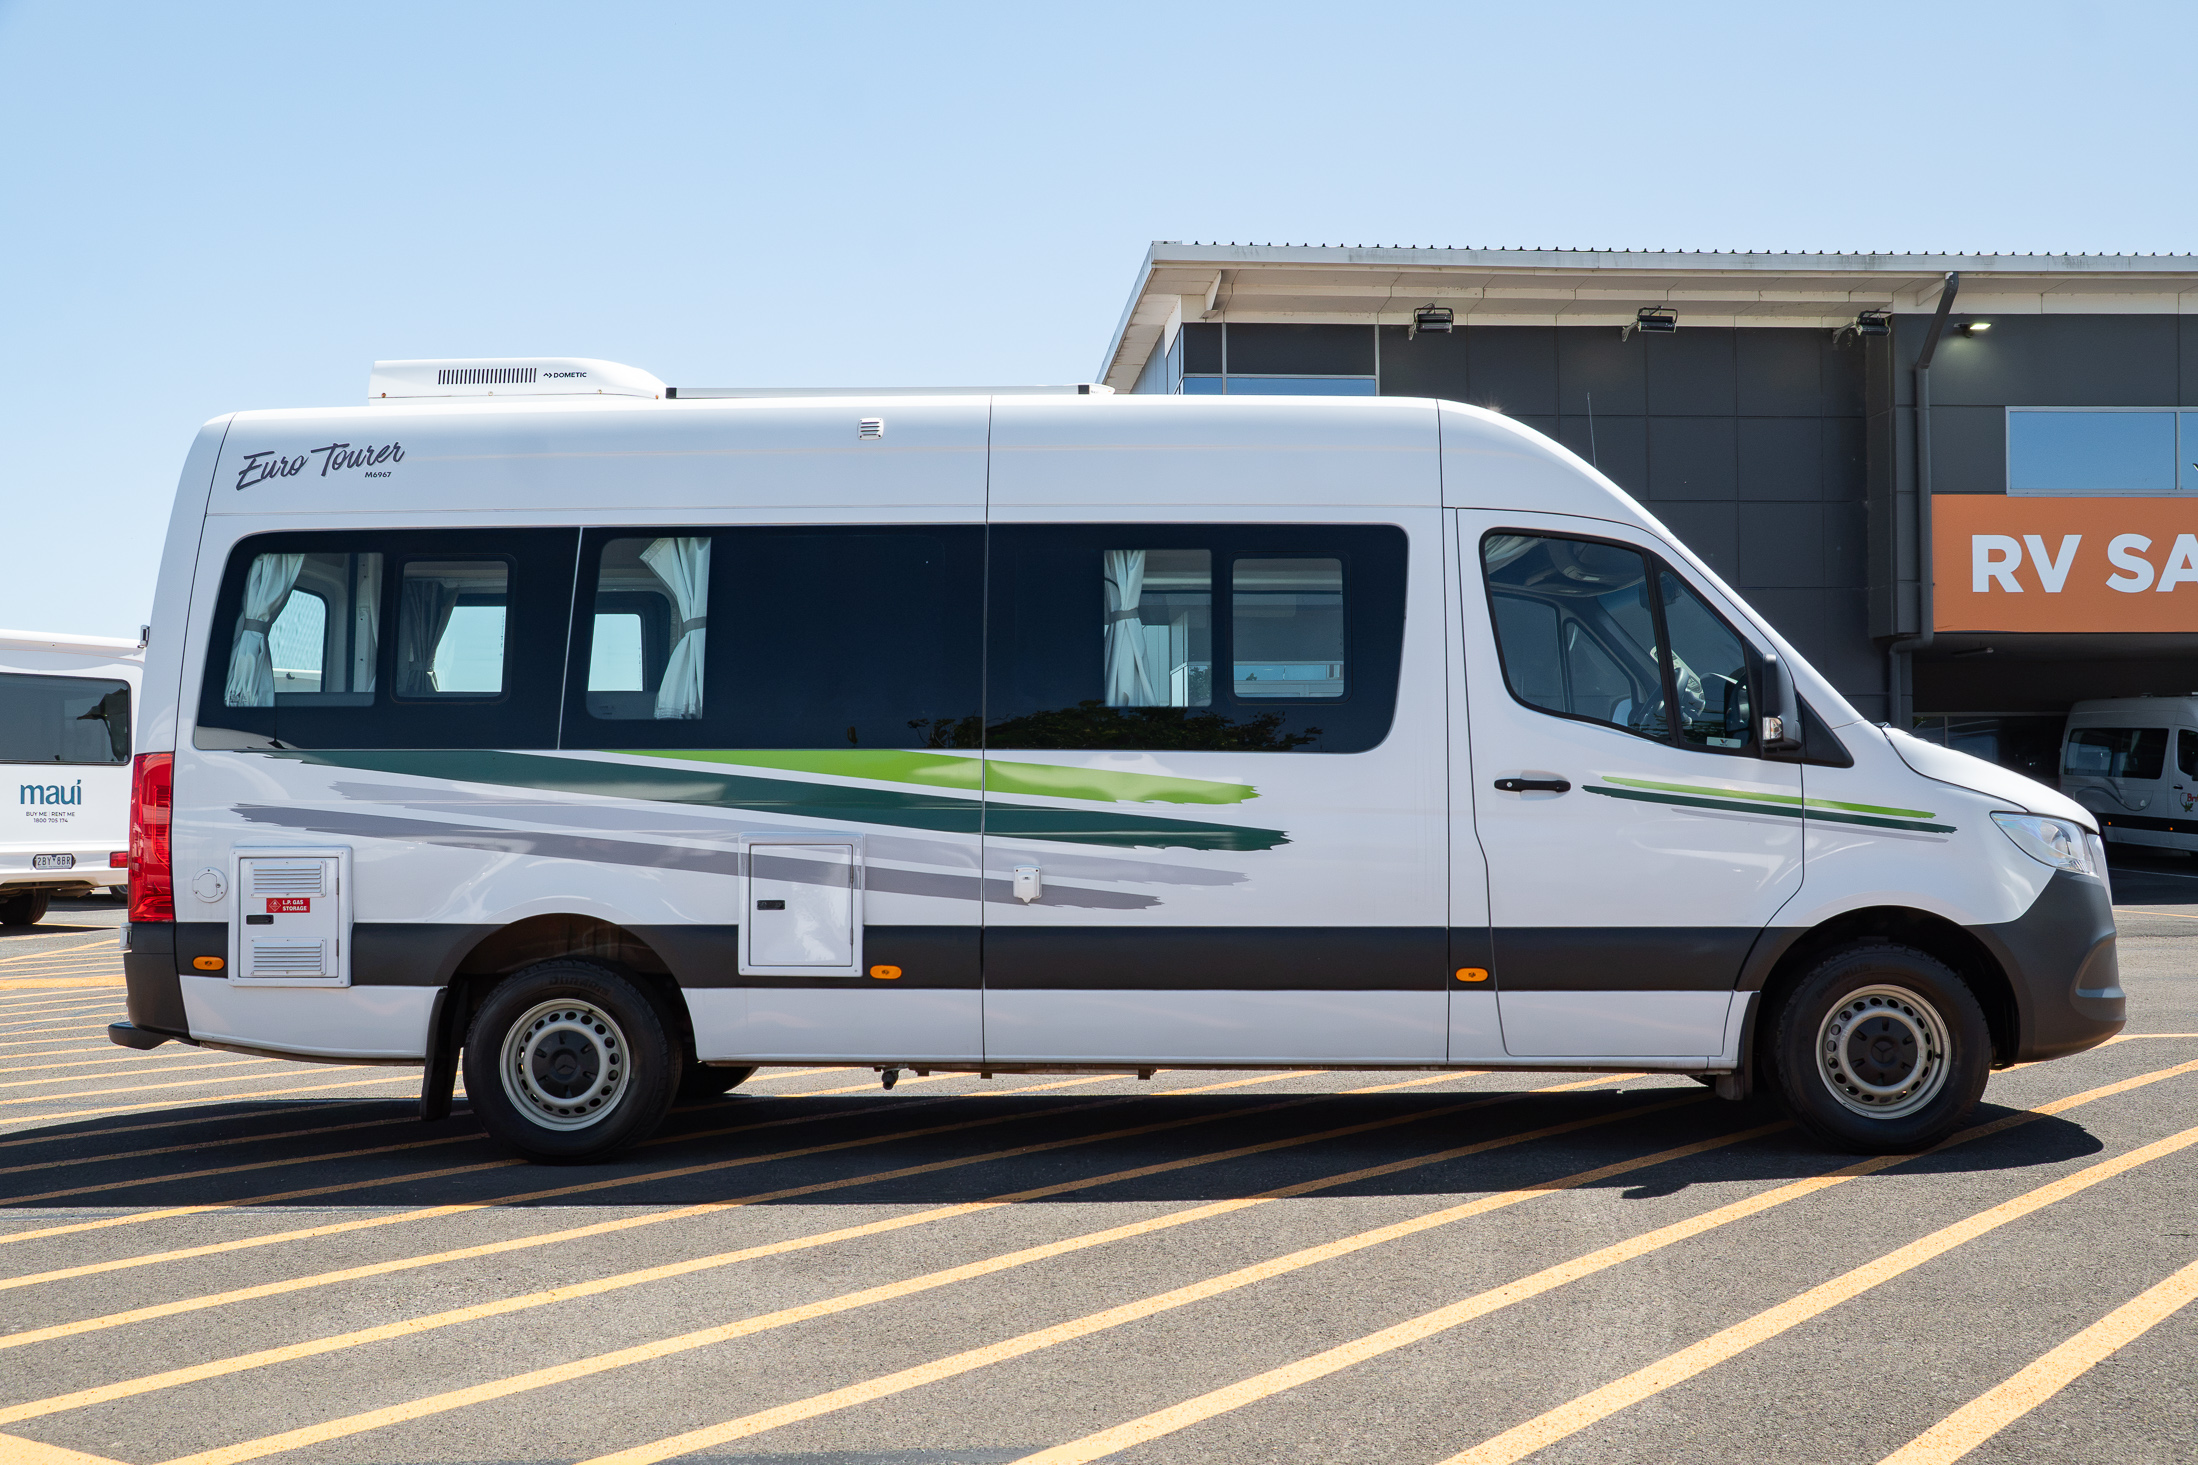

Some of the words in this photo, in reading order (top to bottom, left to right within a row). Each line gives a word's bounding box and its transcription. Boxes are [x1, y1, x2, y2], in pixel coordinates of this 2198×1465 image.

[553, 371, 588, 379] DOMETIC
[235, 450, 309, 491] Euro
[310, 441, 406, 477] Tourer
[364, 471, 392, 479] M6967
[1971, 534, 2083, 593] RV
[2105, 533, 2198, 593] SA
[20, 779, 82, 805] maui
[37, 856, 52, 866] 2BY
